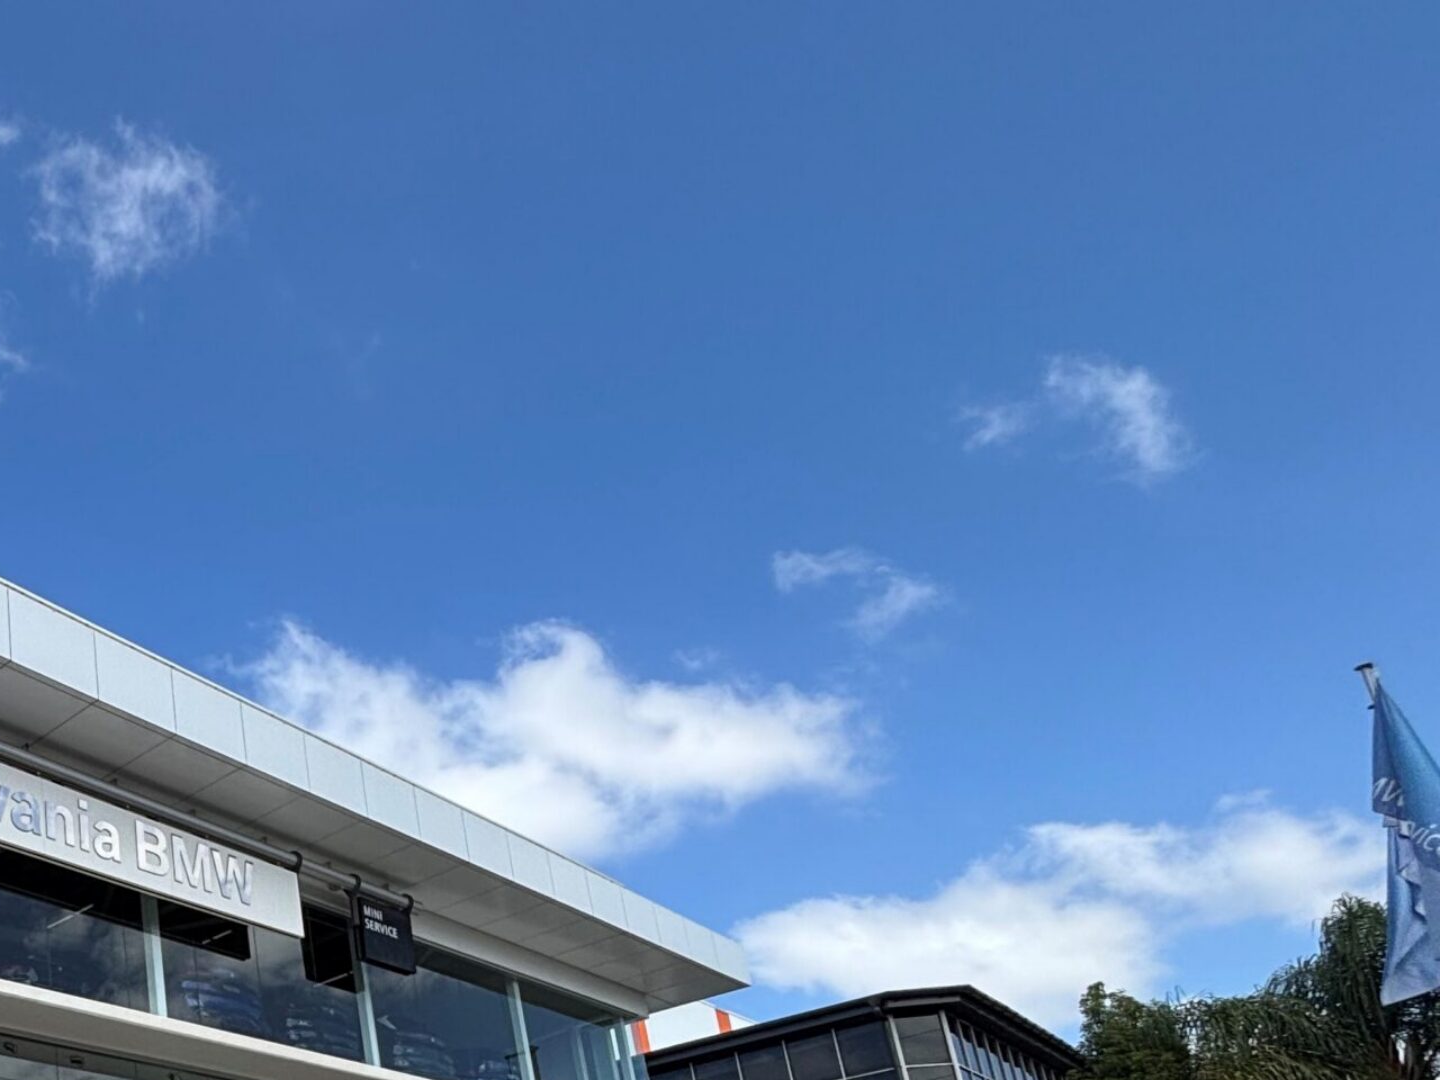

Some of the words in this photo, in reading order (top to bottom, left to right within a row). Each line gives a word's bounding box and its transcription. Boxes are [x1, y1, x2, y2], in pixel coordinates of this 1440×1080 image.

[135, 819, 254, 906] BMW
[363, 904, 383, 921] MINI
[364, 917, 398, 939] SERVICE
